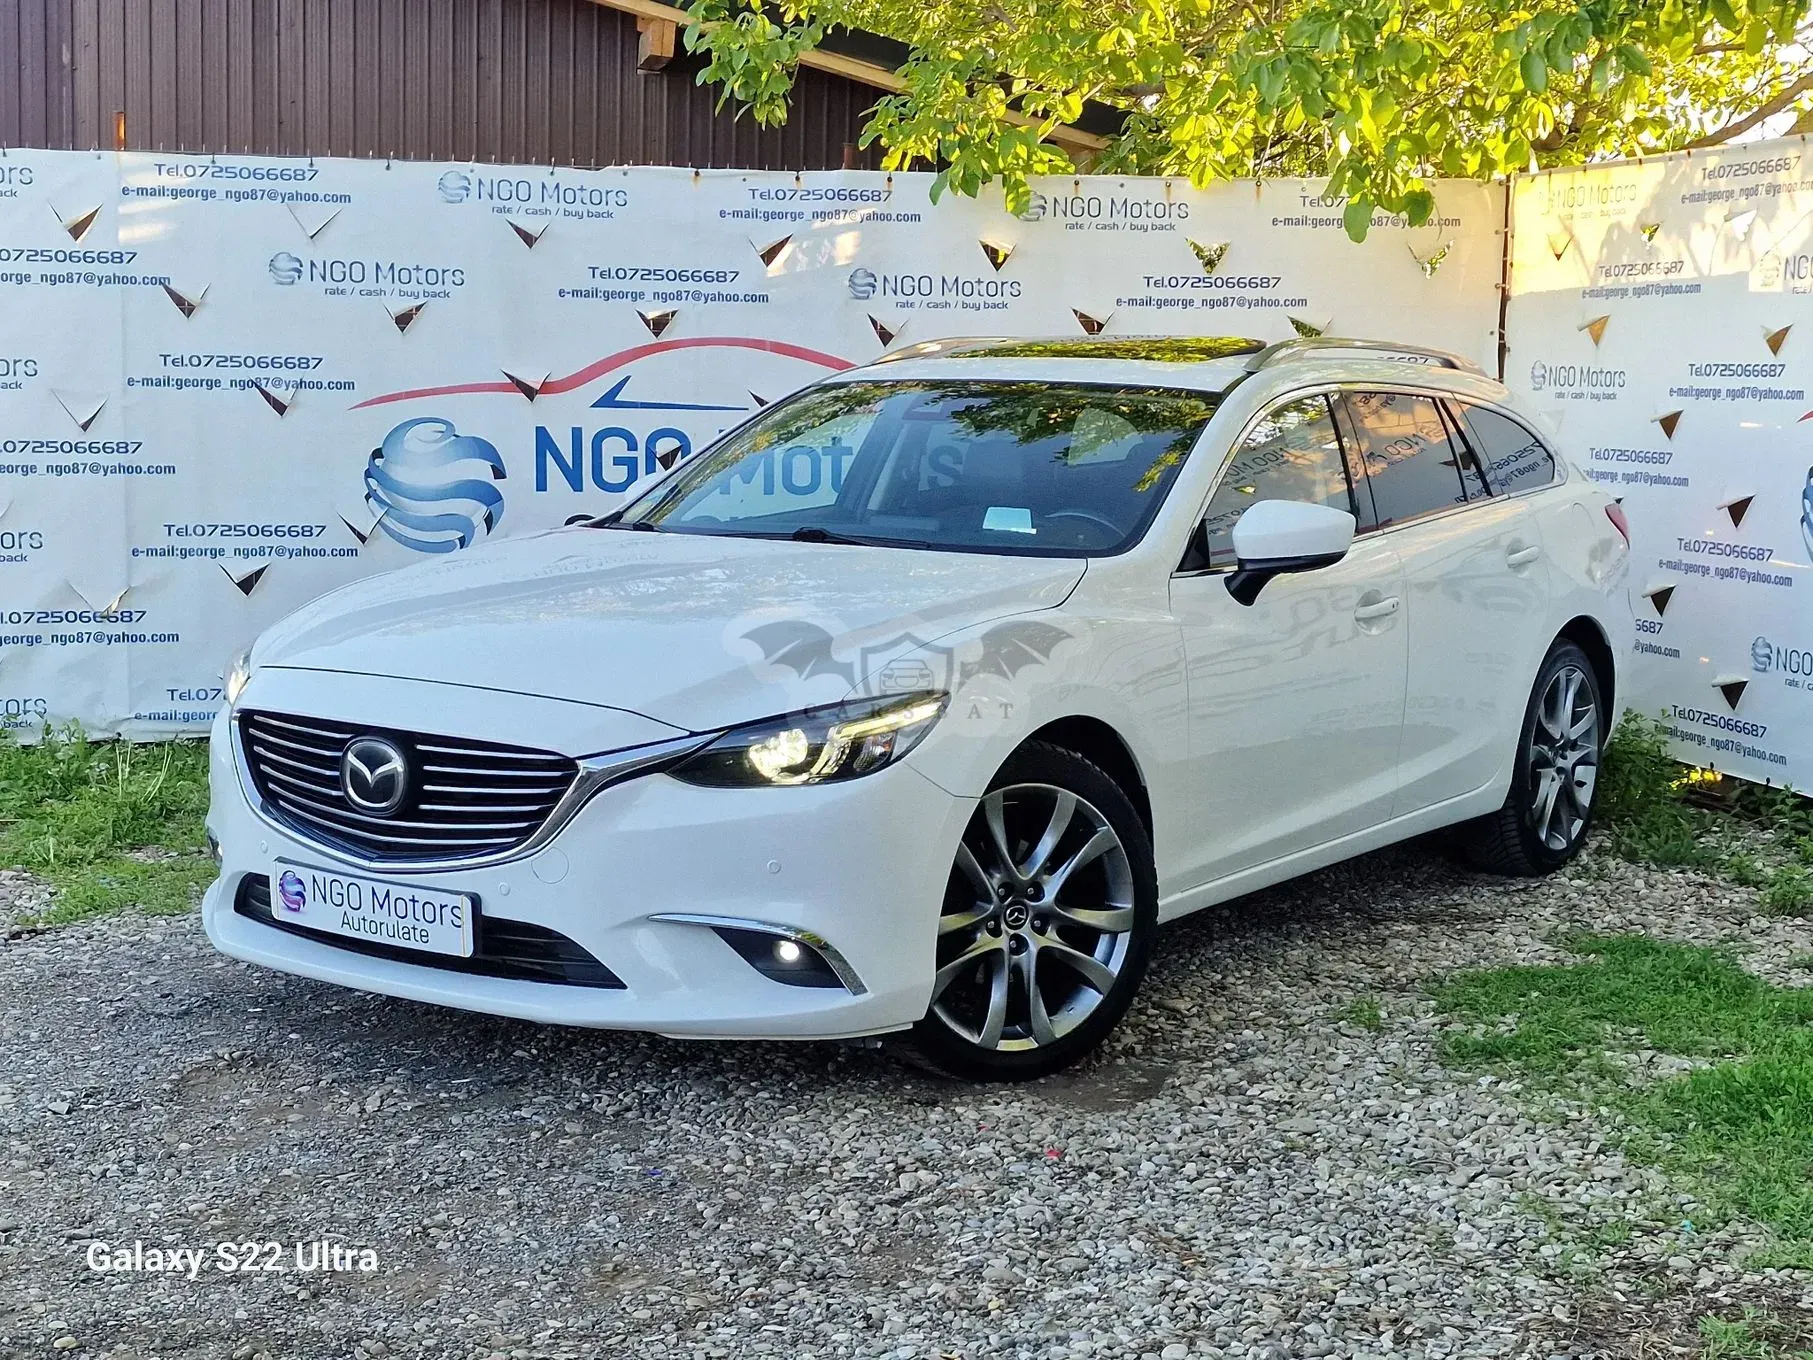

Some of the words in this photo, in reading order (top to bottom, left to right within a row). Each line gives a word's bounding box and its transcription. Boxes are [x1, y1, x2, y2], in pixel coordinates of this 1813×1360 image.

[154, 163, 320, 182] Tel.0725066687
[122, 184, 351, 205] e-mail:george_ngo87@yahoo.com
[477, 178, 532, 203] NGO
[541, 181, 628, 208] Motors
[749, 187, 892, 203] Tel.0725066687
[491, 205, 513, 215] rate
[525, 207, 552, 217] cash
[563, 208, 584, 220] buy
[586, 209, 615, 220] back
[719, 207, 921, 225] e-mail:george_ngo87@yahoo.com
[1052, 196, 1103, 219] NGO
[1109, 197, 1190, 220] Motors
[1065, 221, 1084, 231] rate
[1096, 221, 1120, 231] cash
[1129, 221, 1149, 233] buy
[1151, 221, 1176, 232] back
[309, 259, 366, 284] NGO
[375, 260, 465, 287] Motors
[588, 266, 740, 284] Tel.0725066687
[1784, 255, 1813, 280] NG
[883, 275, 933, 296] NGO
[941, 276, 1021, 297] Motors
[1143, 275, 1281, 290] Tel.0725066687
[324, 286, 347, 296] rate
[359, 287, 387, 297] cash
[398, 288, 420, 300] buy
[423, 288, 452, 299] back
[558, 286, 770, 305] e-mail:george_ngo87@yahoo.com
[896, 300, 915, 308] rate
[962, 301, 981, 311] buy
[984, 301, 1008, 309] back
[1115, 294, 1308, 311] e-mail:george_ngo87@yahoo.com
[159, 354, 324, 370] Tel.0725066687
[1689, 363, 1785, 378] Tel.0725066687
[127, 375, 356, 393] e-mail:george_ngo87@yahoo.com
[1548, 366, 1575, 387] NGO
[1580, 366, 1626, 387] Motors
[1669, 386, 1804, 401] e-mail:george_ngo87@yahoo.com
[1590, 448, 1673, 464] Tel.0725066687
[162, 523, 327, 539] Tel.0725066687
[0, 531, 43, 550] ors
[131, 543, 359, 560] e-mail:george_ngo87@yahoo.com
[1677, 538, 1774, 562] Tel.0725066687
[1658, 559, 1793, 587] e-mail:george_ngo87@yahoo.com
[1776, 647, 1812, 676] NGO
[0, 698, 47, 716] ors
[1672, 705, 1767, 738] Tel.0725066687
[312, 874, 362, 911] NGO
[371, 886, 463, 929] Motors
[341, 911, 430, 944] Autorulate
